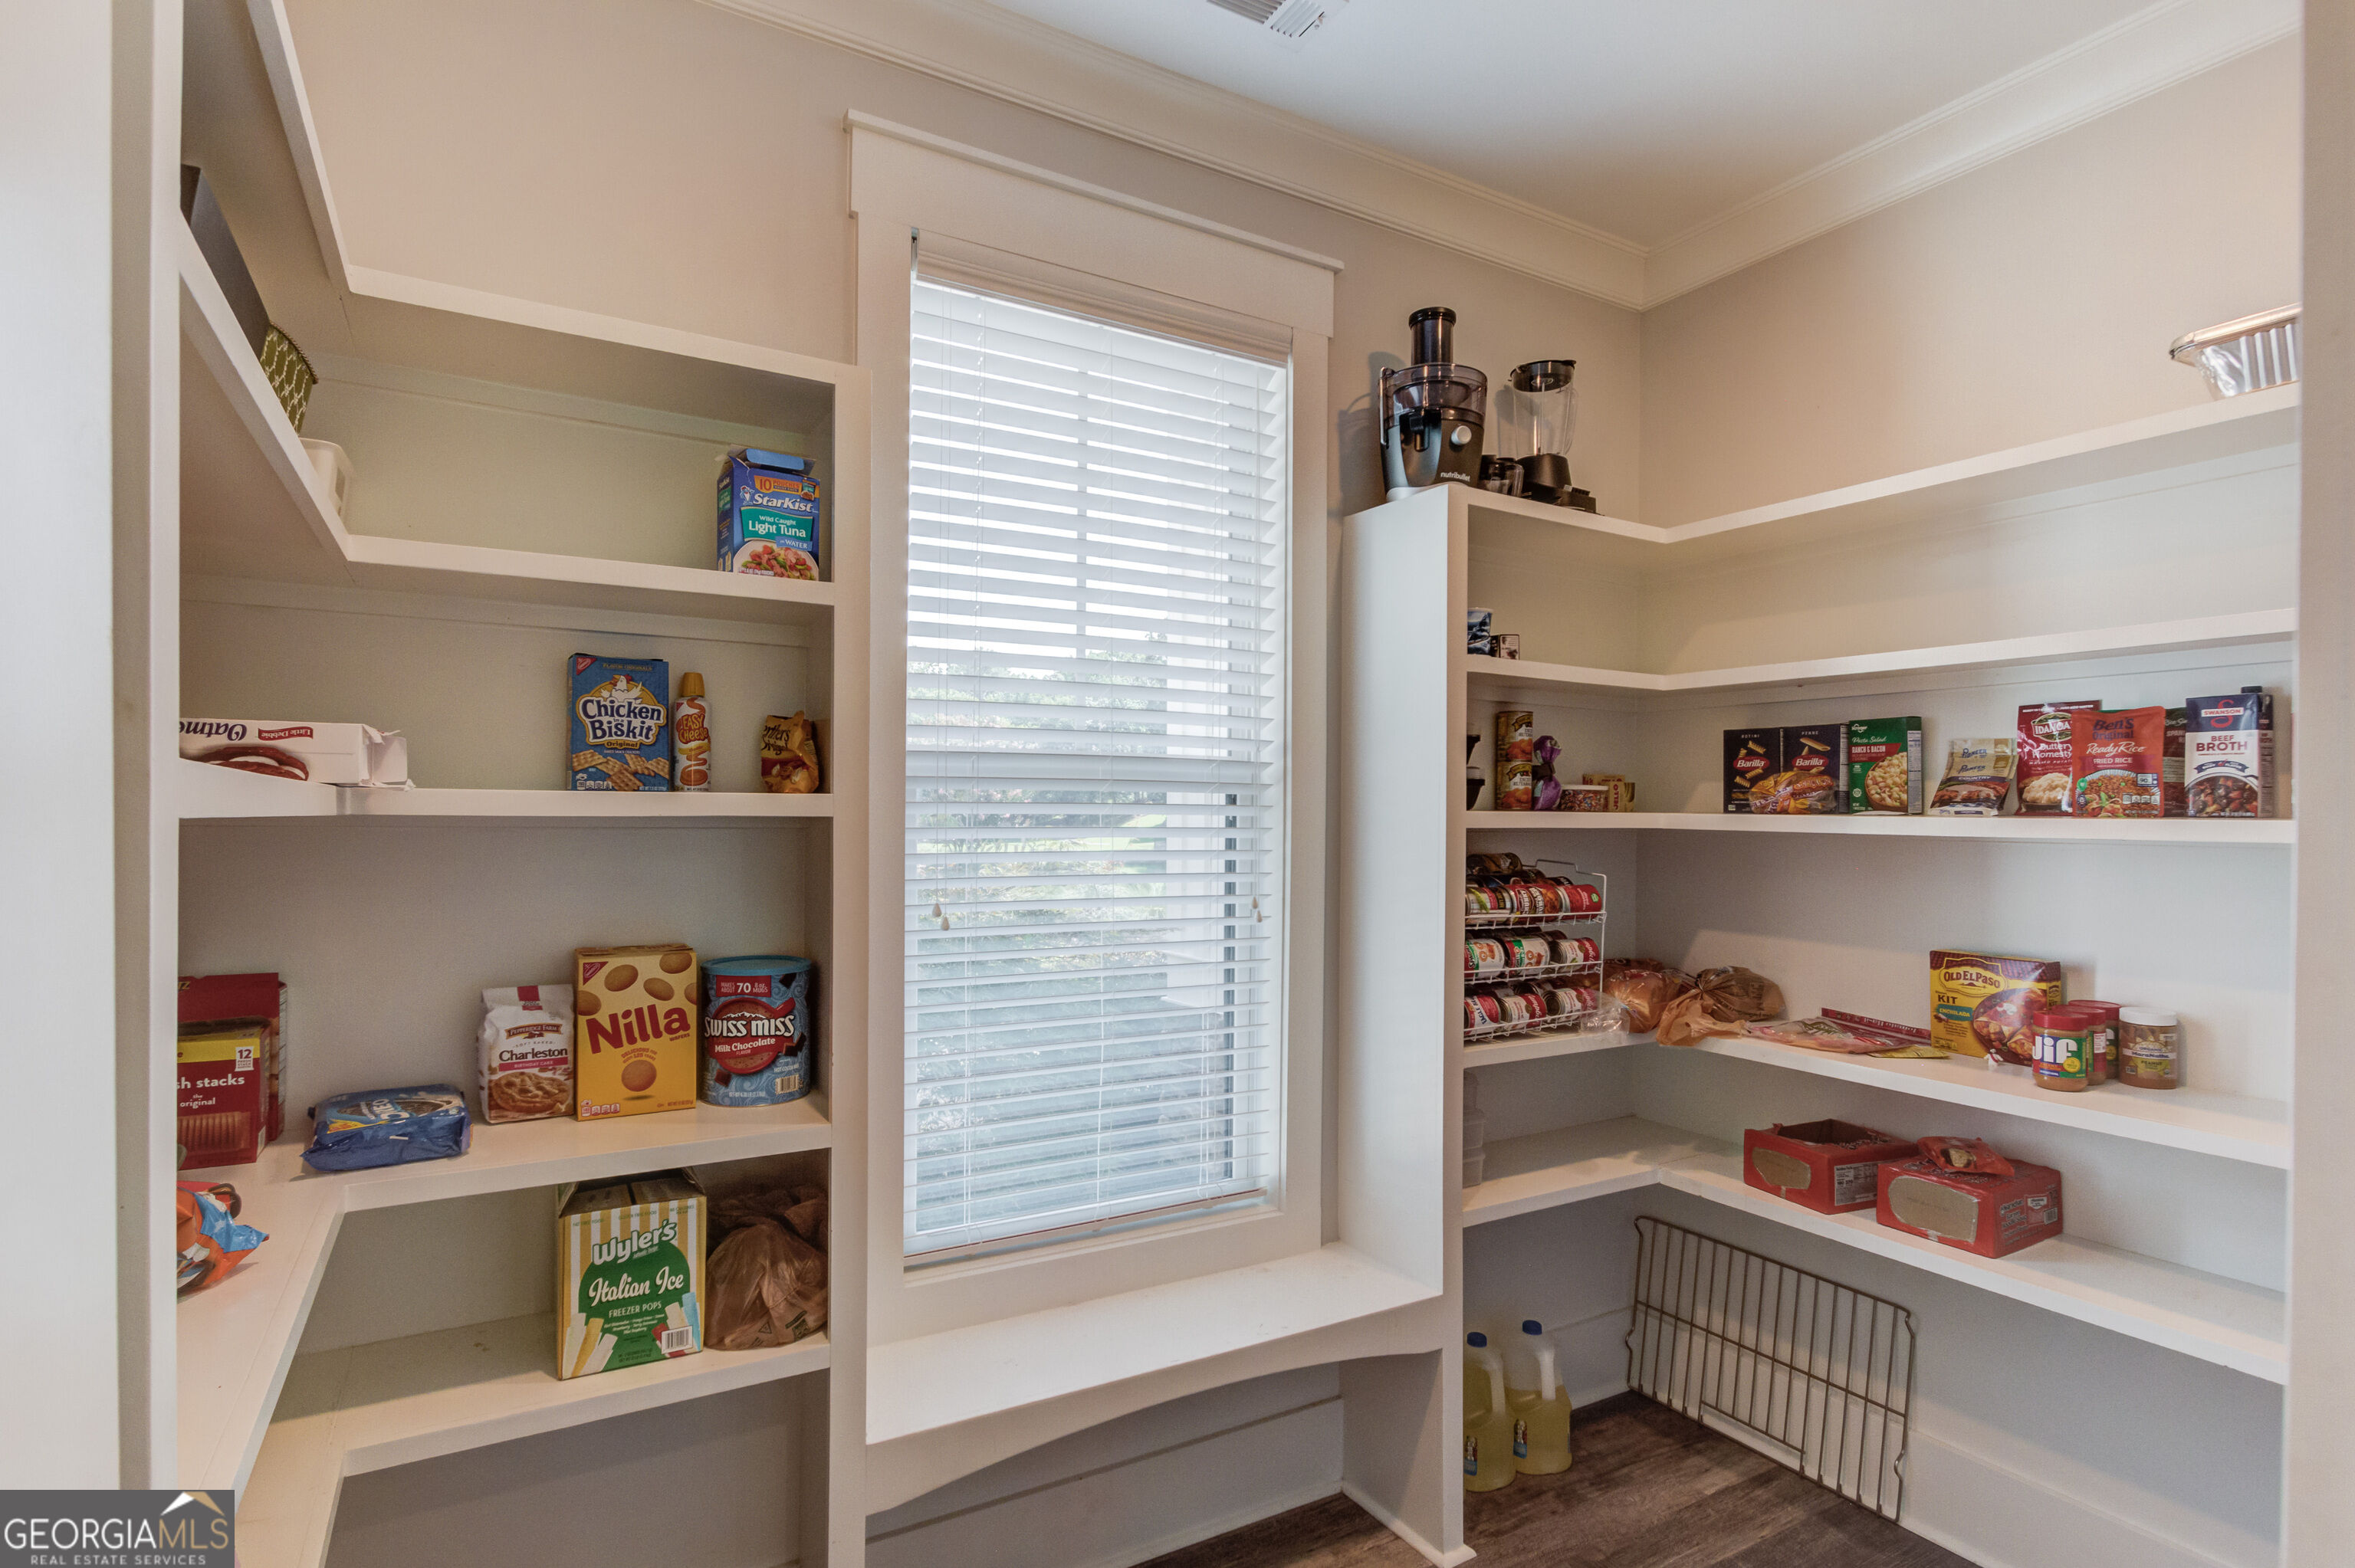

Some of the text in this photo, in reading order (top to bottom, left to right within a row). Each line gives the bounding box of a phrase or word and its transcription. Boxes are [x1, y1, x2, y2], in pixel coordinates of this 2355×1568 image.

[1440, 472, 1471, 482] nutribullet
[759, 479, 772, 493] 10
[753, 493, 814, 513] StarKist
[749, 520, 806, 537] Light Tuna
[775, 517, 796, 527] Caught
[785, 539, 808, 549] WATER
[581, 699, 662, 722] Chicken
[682, 714, 704, 730] EASY
[2035, 721, 2071, 735] IDAHOA
[2093, 717, 2134, 732] Ben's
[179, 720, 248, 741] Oatme
[261, 727, 311, 738] Little Debbie
[589, 719, 653, 740] Biskit
[2092, 730, 2134, 742] Original
[2196, 741, 2248, 753] BROTH
[1795, 757, 1825, 766] Barilla
[2032, 751, 2073, 759] Homesty
[1736, 759, 1766, 768] Barilla
[1943, 971, 1962, 982] OLD
[1962, 970, 1975, 982] EL
[737, 982, 751, 993] 70
[1937, 994, 1958, 1005] KIT
[1939, 1008, 1971, 1018] ENCHILADA
[510, 1024, 558, 1036] PEPPERIDGE FARM
[586, 1004, 691, 1055] Nilla
[705, 1016, 748, 1038] SWISS
[669, 1033, 691, 1042] WAFERS
[714, 1038, 777, 1053] Milk Chocolate
[2032, 1035, 2077, 1064] Jif
[238, 1049, 252, 1059] 12
[499, 1048, 569, 1062] Charleston
[196, 1074, 245, 1088] stacks
[180, 1097, 216, 1109] original
[593, 1219, 678, 1265] Wyler's
[589, 1266, 684, 1307] Italian Ice
[609, 1301, 662, 1318] FREEZER POPS
